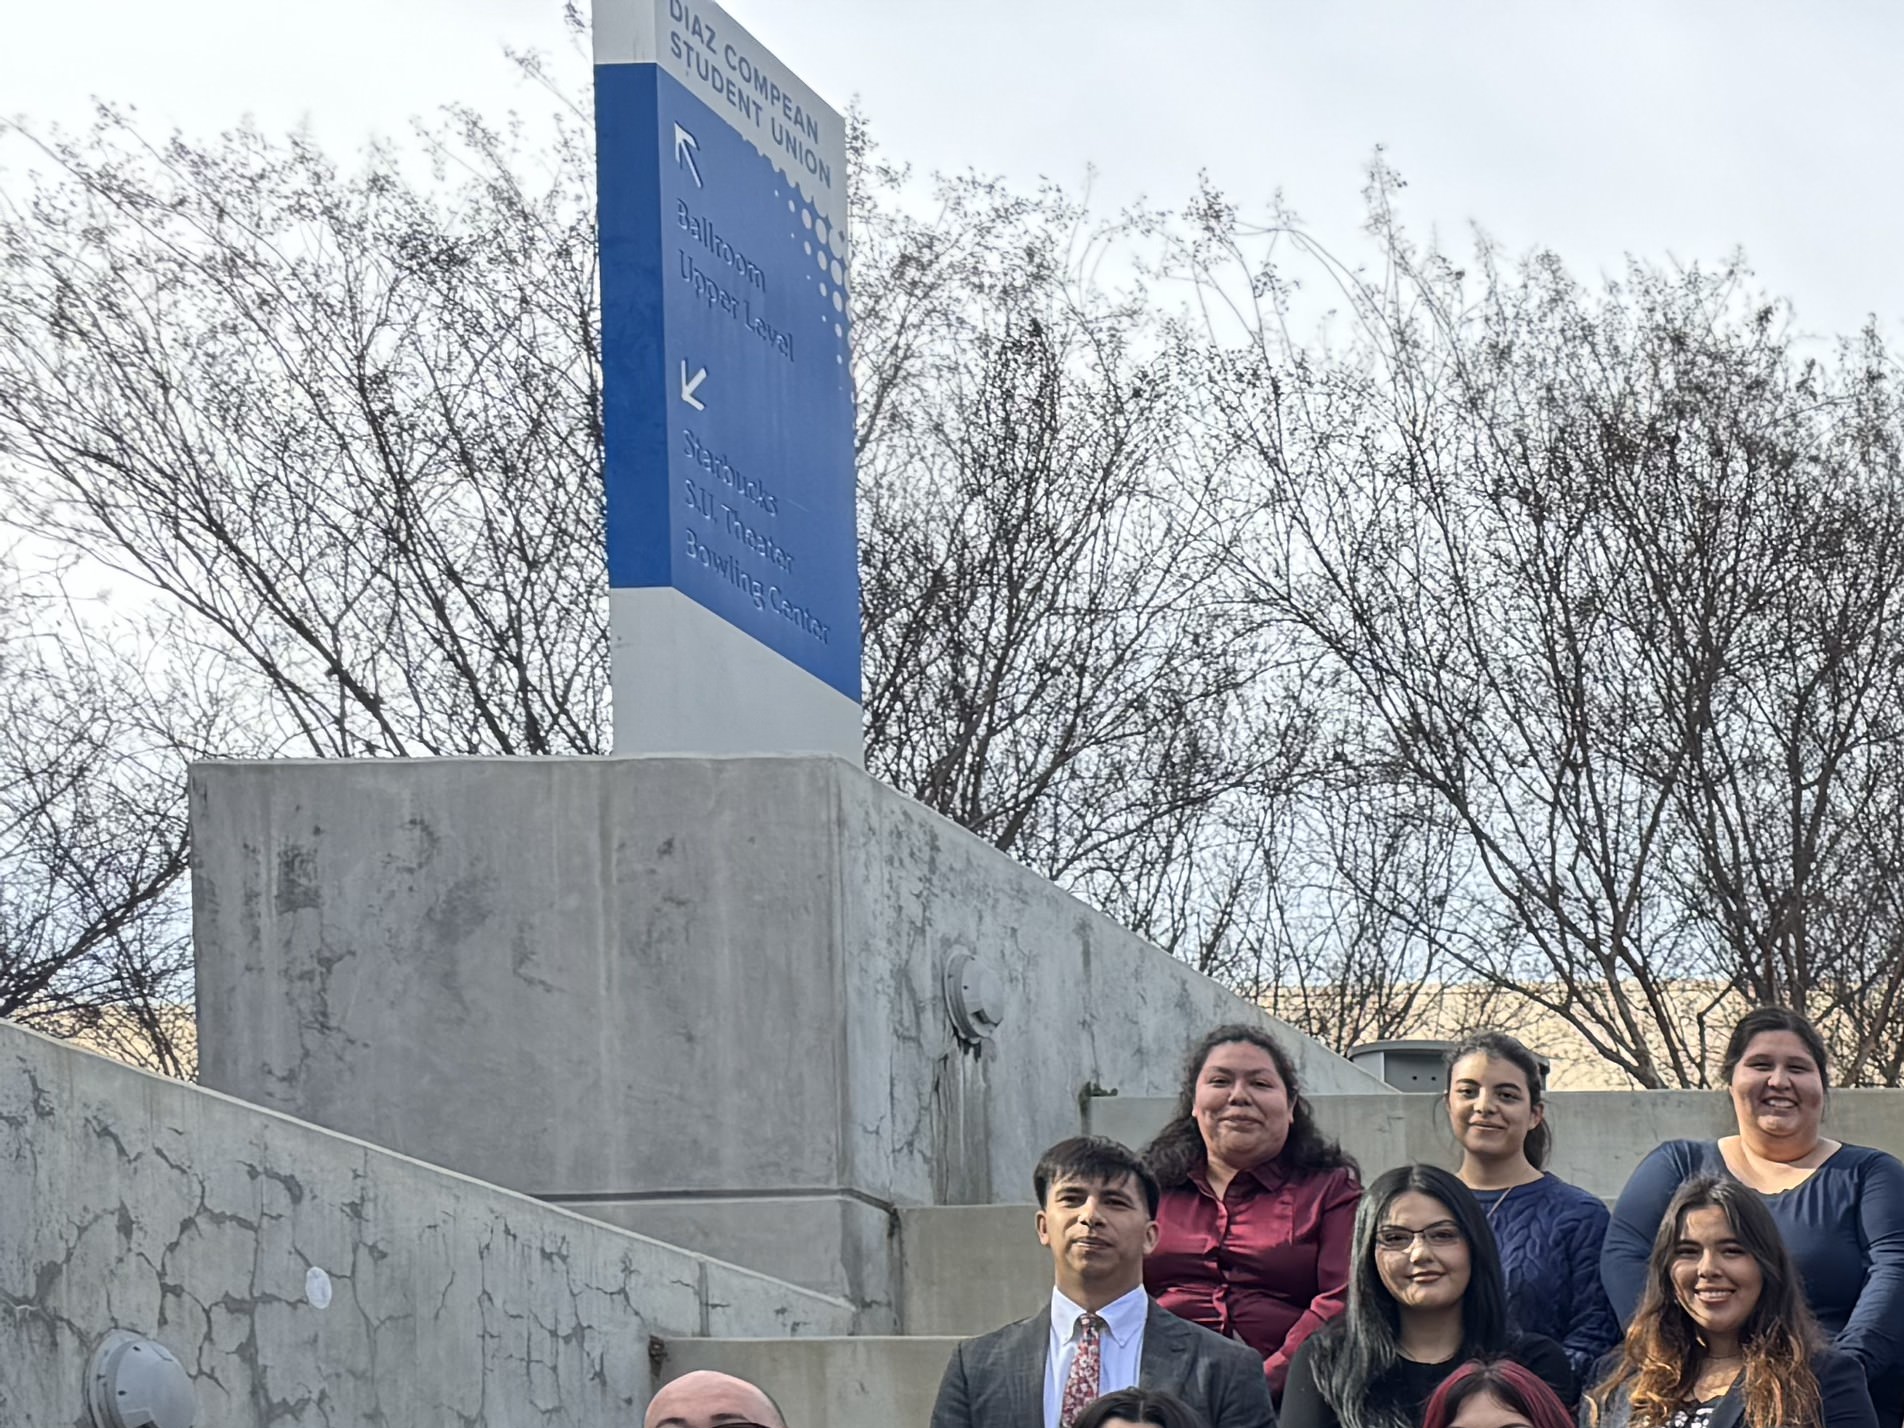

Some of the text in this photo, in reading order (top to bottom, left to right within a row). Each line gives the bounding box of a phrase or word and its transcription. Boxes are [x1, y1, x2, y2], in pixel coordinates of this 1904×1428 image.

[669, 0, 819, 144] DIAZ COMPEAN
[671, 31, 831, 189] STUDENT UNION
[677, 198, 766, 292] Ballroom
[680, 249, 794, 362] Upper Level
[683, 429, 778, 516] Starbucks
[684, 479, 794, 574] S.U. Theater
[685, 528, 830, 645] Bowling Center
